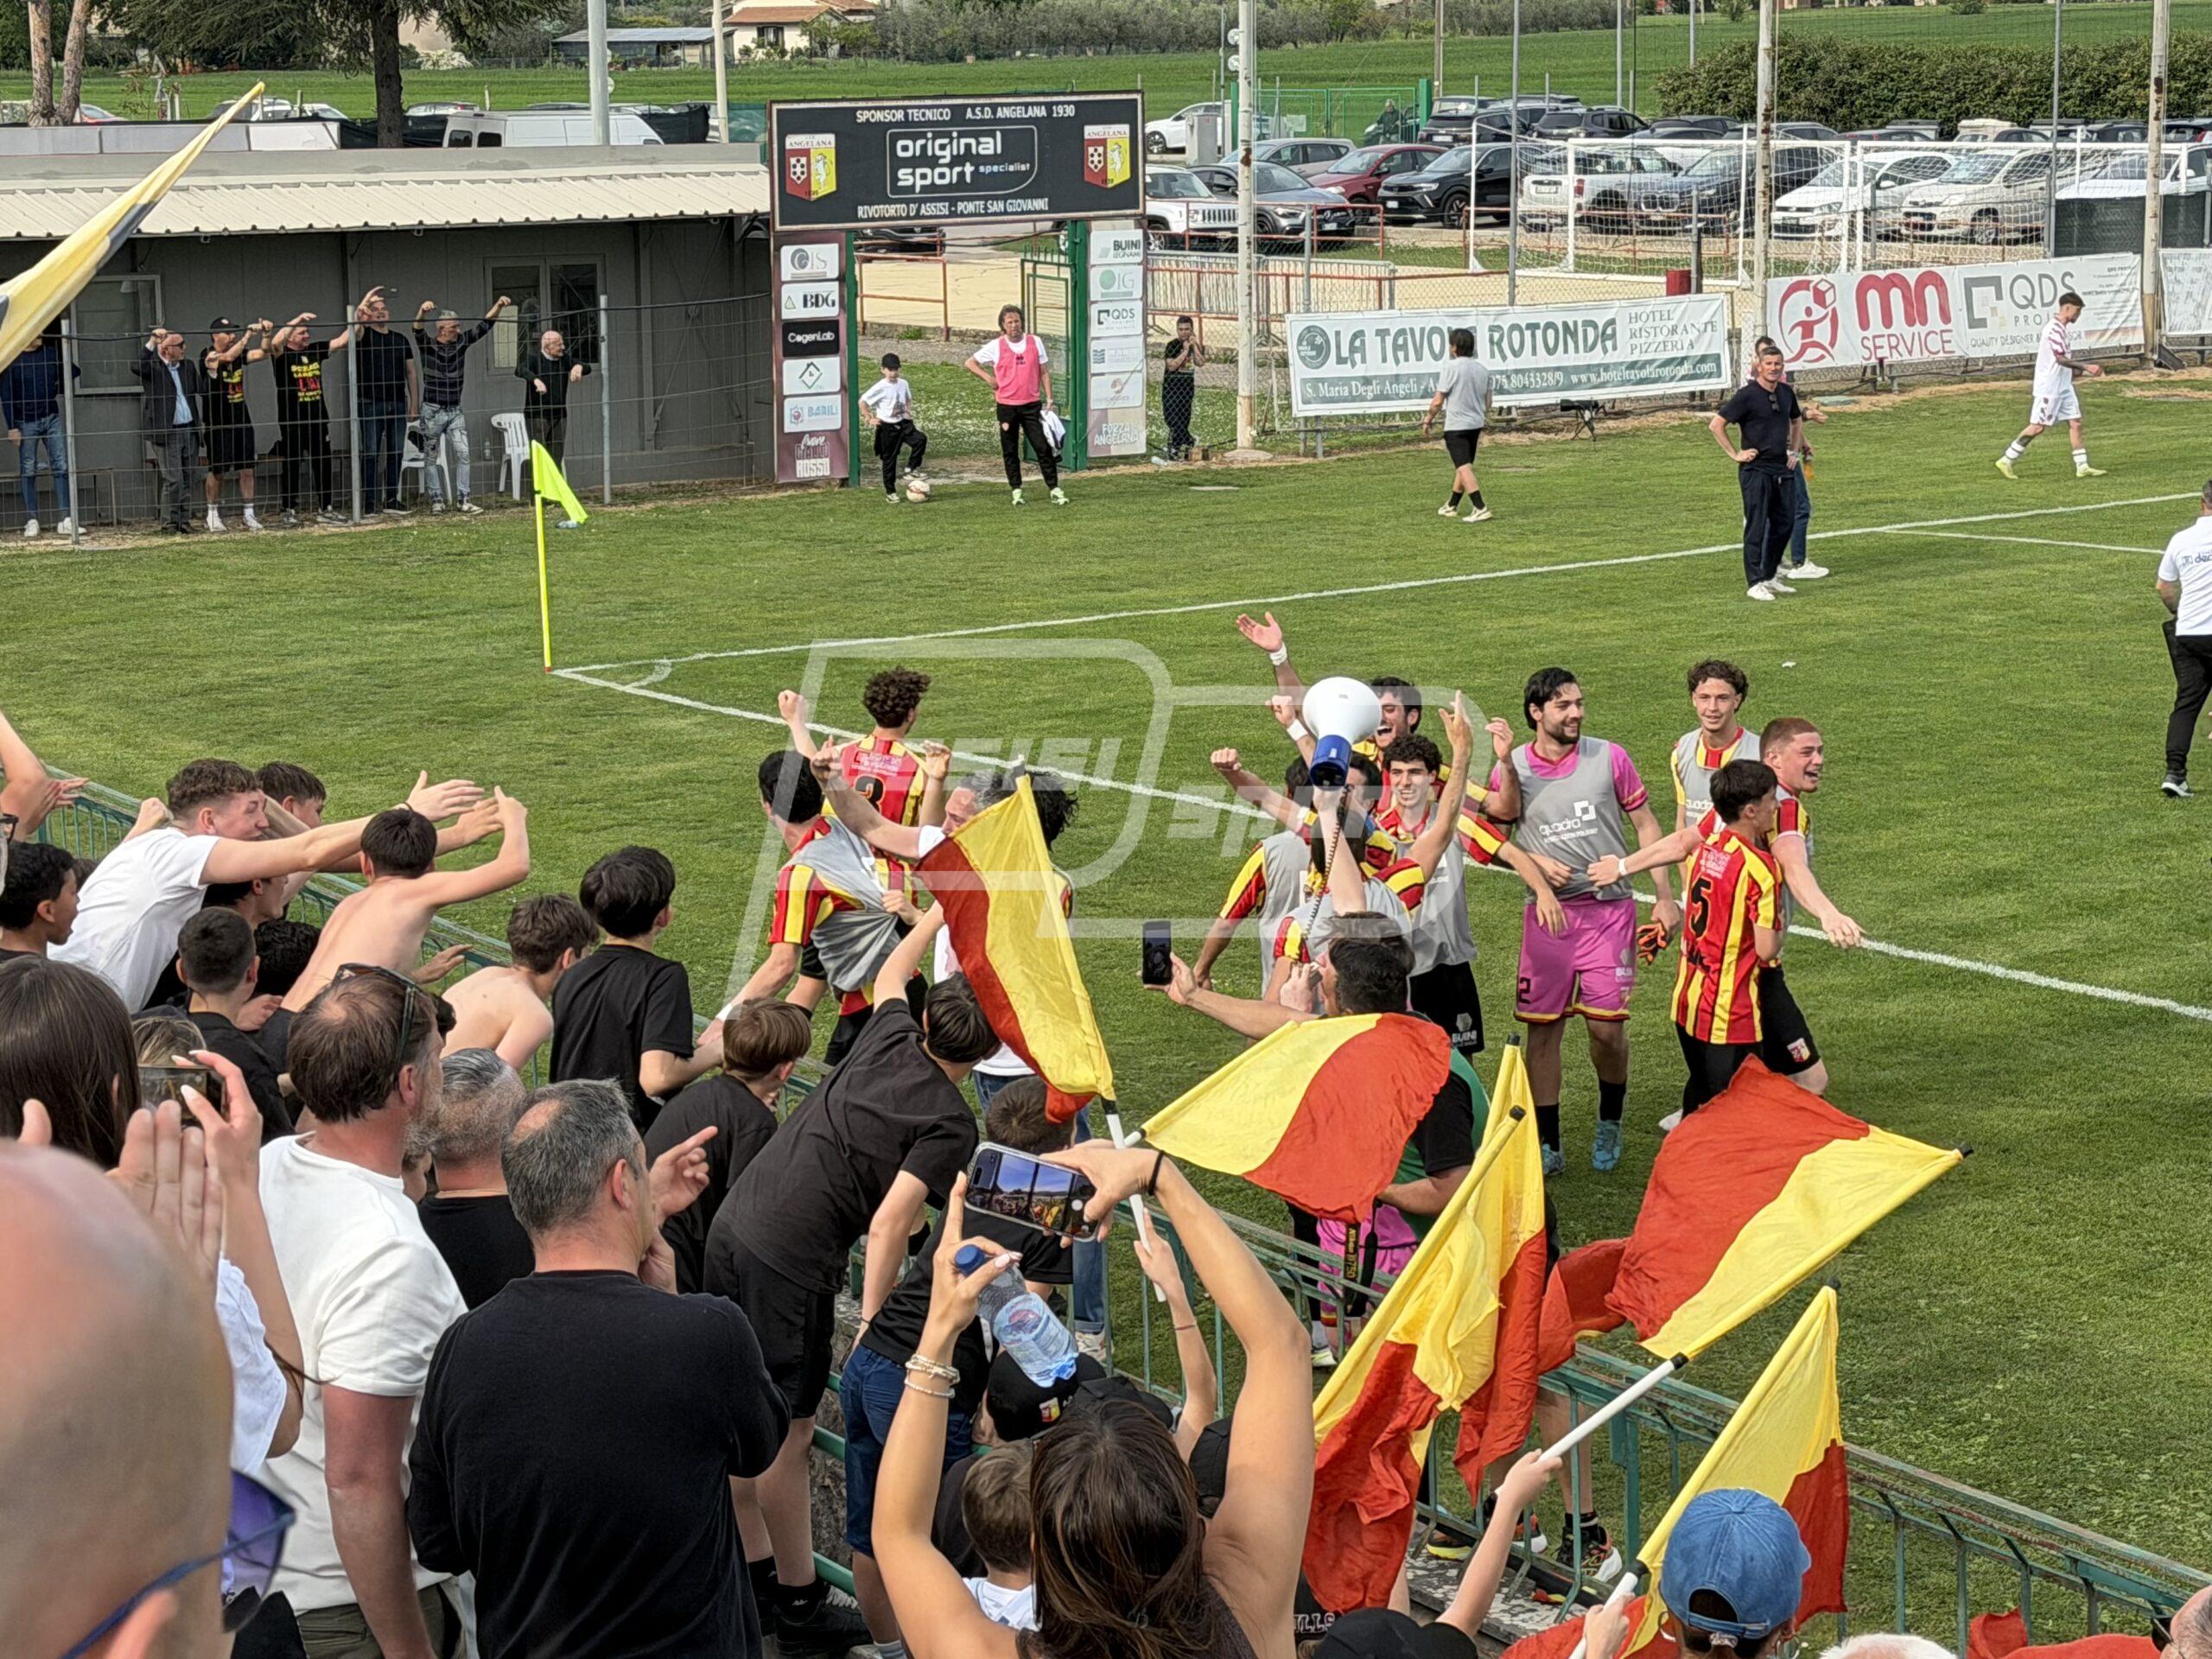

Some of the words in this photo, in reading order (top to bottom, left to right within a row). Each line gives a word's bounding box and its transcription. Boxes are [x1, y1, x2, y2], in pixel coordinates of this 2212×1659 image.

[856, 109, 905, 123] SPONSOR
[907, 108, 950, 121] TECNICO
[965, 106, 994, 119] A.S.D.
[996, 105, 1046, 118] ANGELANA
[1052, 105, 1075, 118] 1930
[896, 130, 1001, 164] original
[897, 162, 975, 194] sport
[978, 162, 1031, 175] specialist
[857, 204, 907, 219] RIVOTORTO
[919, 202, 950, 215] ASSISI
[957, 200, 985, 214] PONTE
[987, 200, 1005, 213] SAN
[1006, 198, 1049, 213] GIOVANNI
[803, 293, 836, 308] BDG
[2009, 270, 2075, 310] QDS
[1629, 309, 1675, 324] HOTEL
[1630, 321, 1719, 340] RISTORANTE
[2000, 333, 2034, 346] DESIGNER
[1335, 329, 1367, 369] LA
[1488, 317, 1618, 363] ROTONDA
[1630, 340, 1696, 356] PIZZERIA
[1860, 329, 1955, 361] SERVICE
[1319, 381, 1349, 398] Maria
[1351, 378, 1381, 400] Degli
[1383, 378, 1418, 398] Angeli
[1691, 876, 1713, 938] 5
